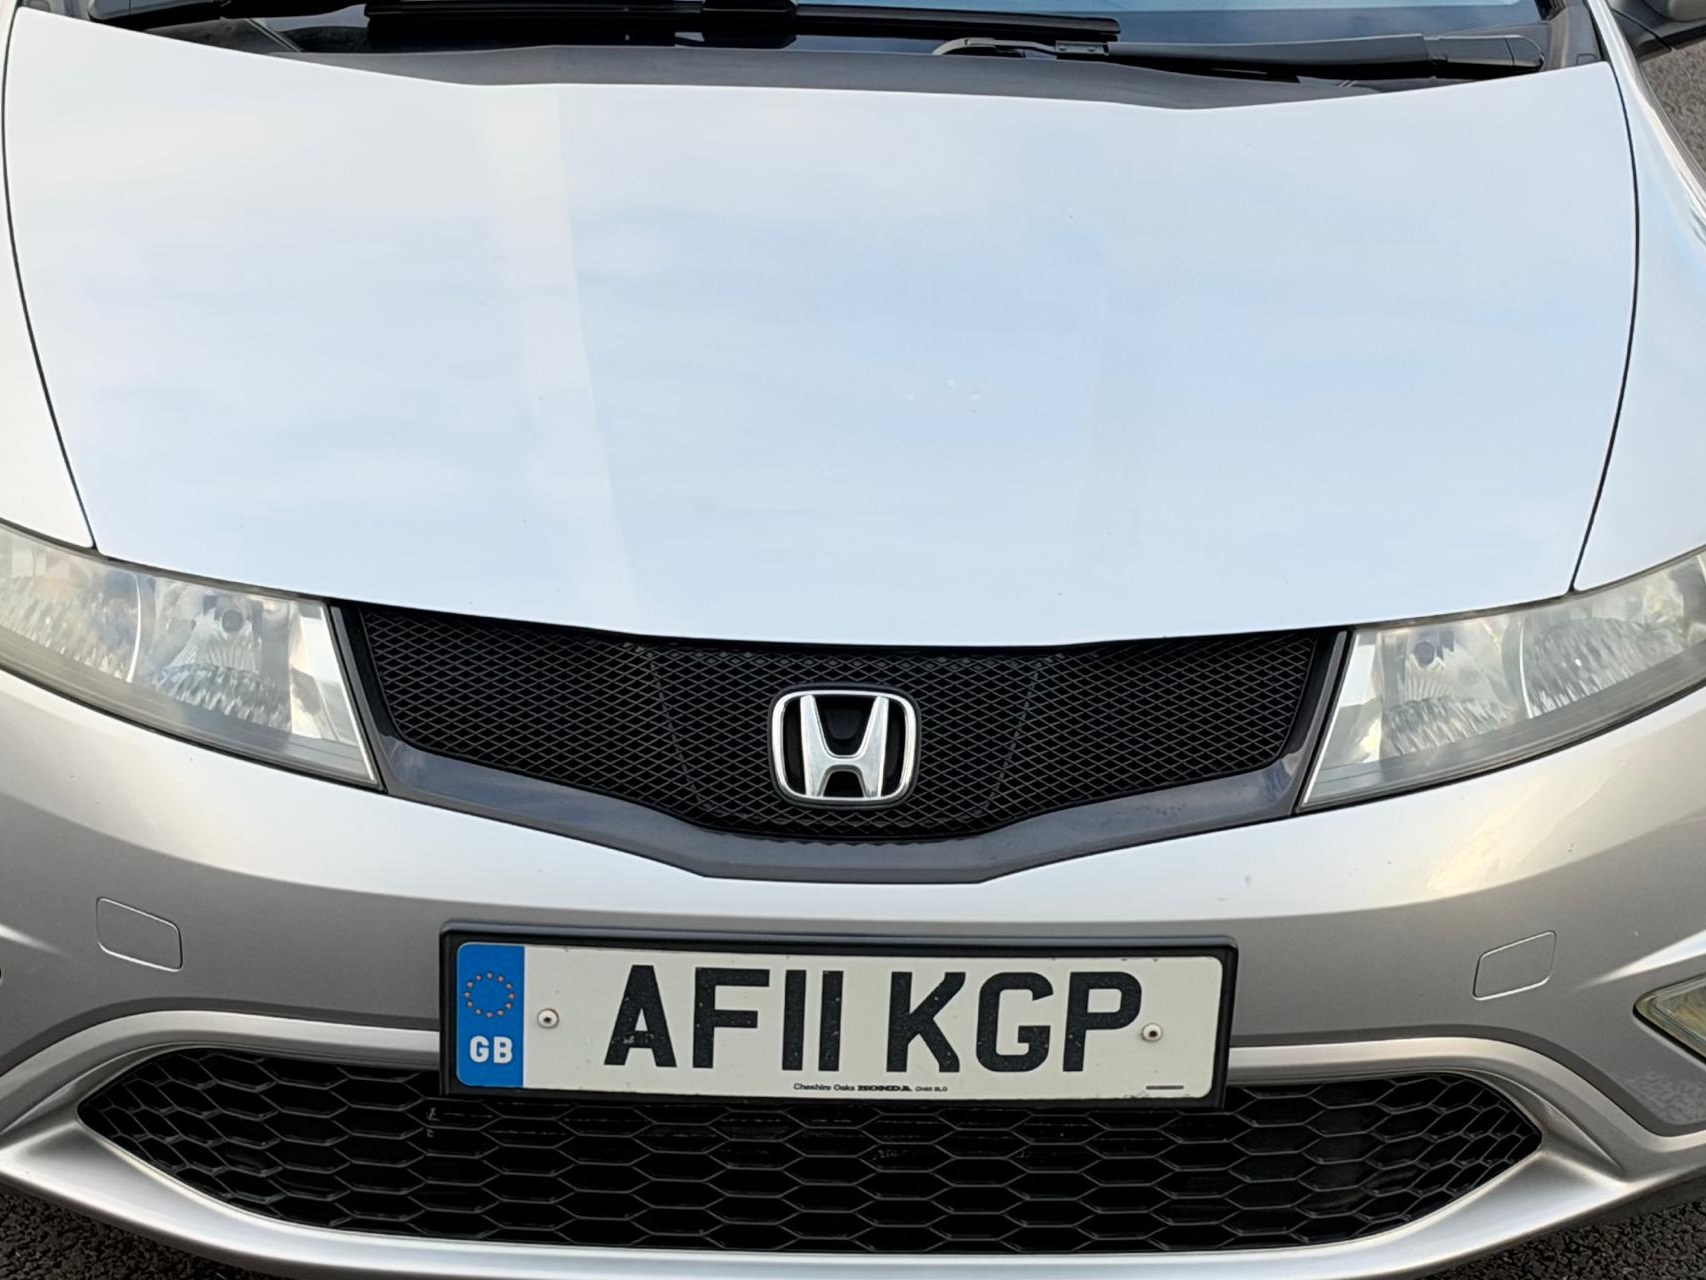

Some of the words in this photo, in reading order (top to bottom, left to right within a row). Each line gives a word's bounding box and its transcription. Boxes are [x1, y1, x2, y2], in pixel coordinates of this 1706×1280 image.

[603, 964, 844, 1072] AF11
[886, 971, 1143, 1073] KGP
[470, 1036, 512, 1063] GB
[833, 1083, 855, 1092] Oaks
